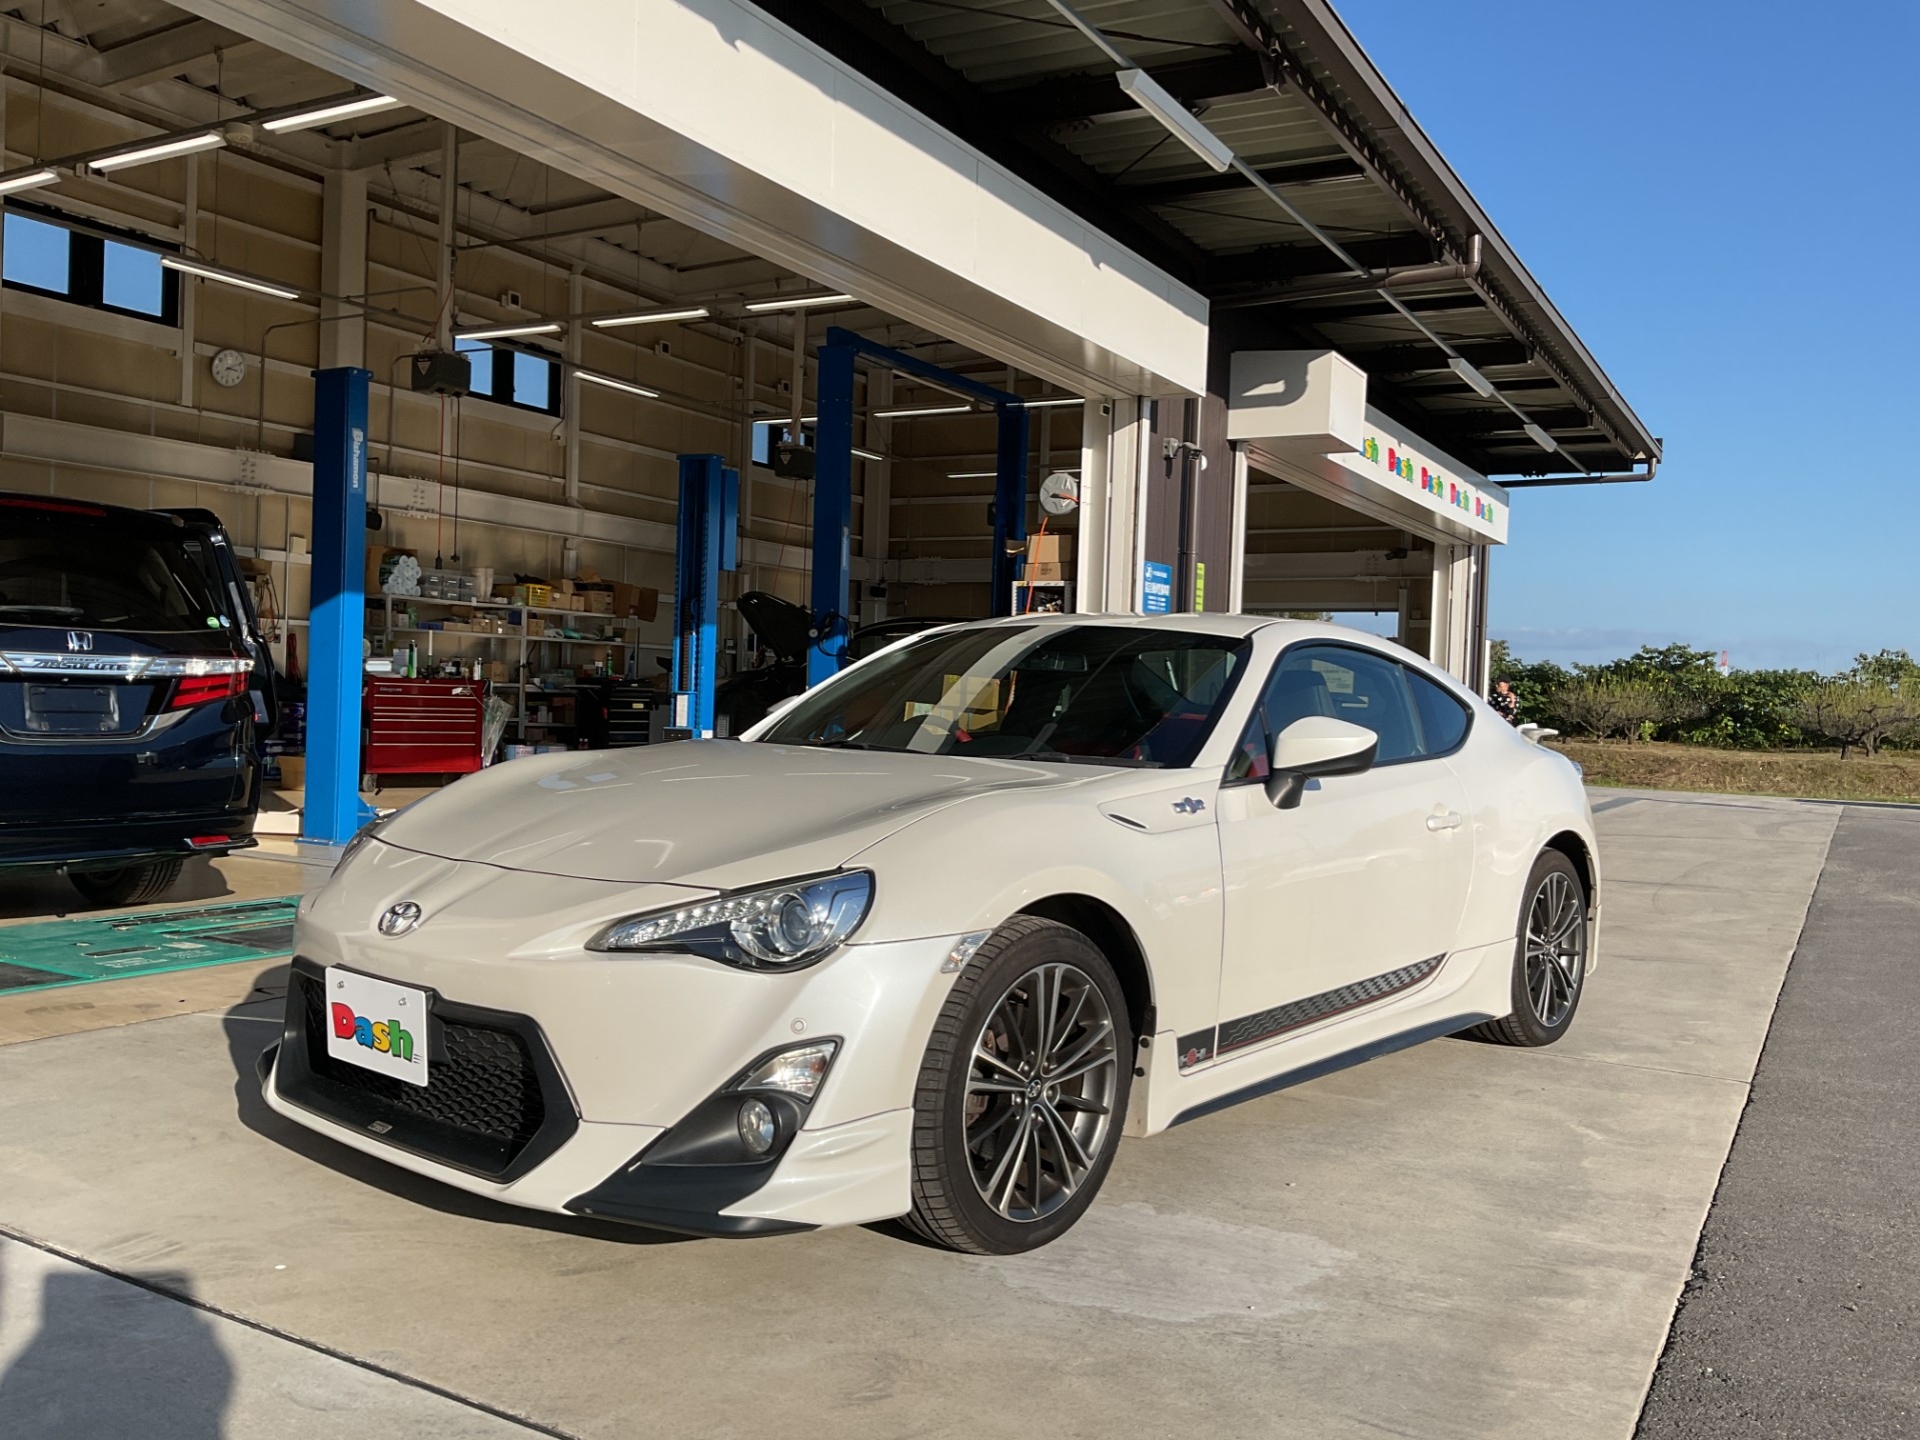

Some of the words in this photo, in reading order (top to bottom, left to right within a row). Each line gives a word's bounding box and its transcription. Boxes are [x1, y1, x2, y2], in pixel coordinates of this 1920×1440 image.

[352, 428, 363, 488] Bishamon
[1360, 437, 1378, 463] sh
[1388, 448, 1413, 482] Dash
[1421, 467, 1443, 498] Dash
[1450, 483, 1469, 511] Dash
[1475, 497, 1493, 523] Dash
[331, 1002, 413, 1062] Dash
